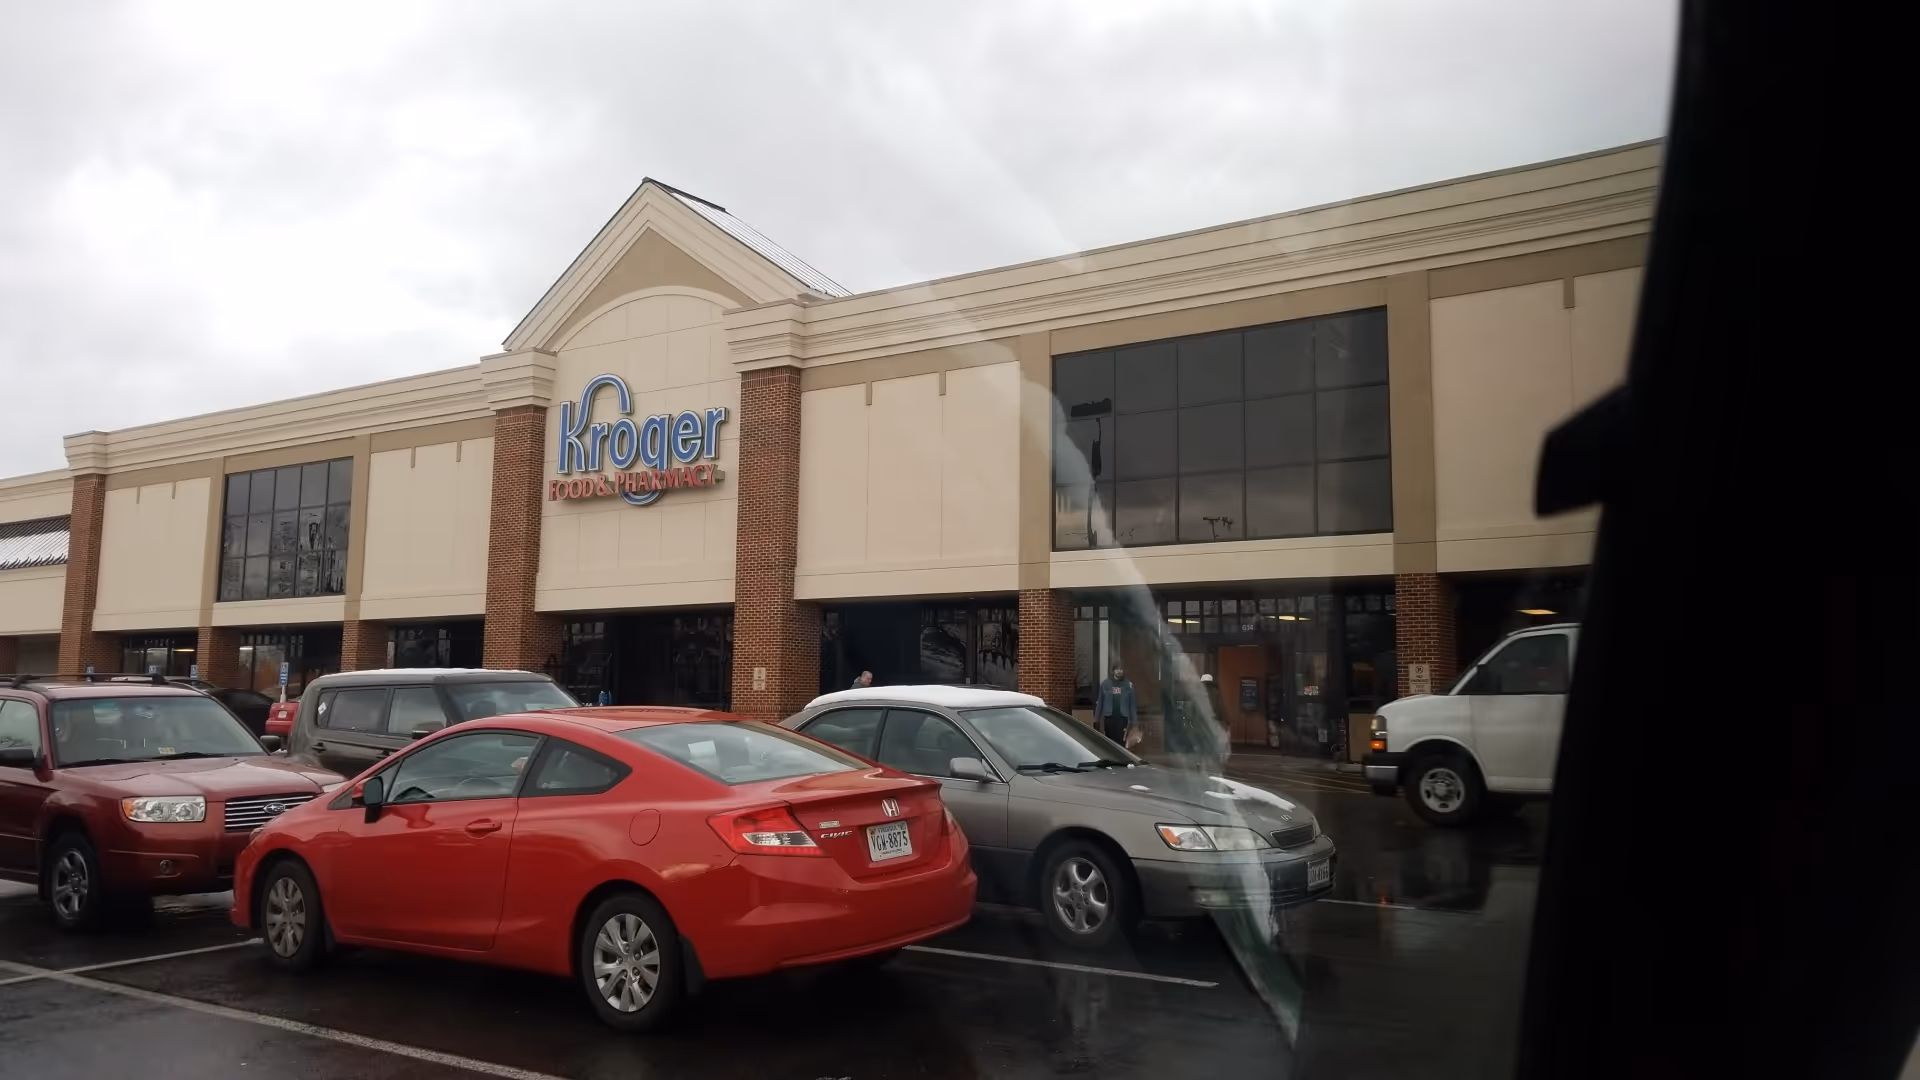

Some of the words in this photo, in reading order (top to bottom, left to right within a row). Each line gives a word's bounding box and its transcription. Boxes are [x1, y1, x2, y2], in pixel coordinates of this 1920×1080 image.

[556, 373, 730, 506] Kroger
[548, 478, 595, 501] FOOD
[595, 474, 614, 496] &
[614, 464, 719, 493] PHARMACY
[820, 830, 853, 839] CIVIC
